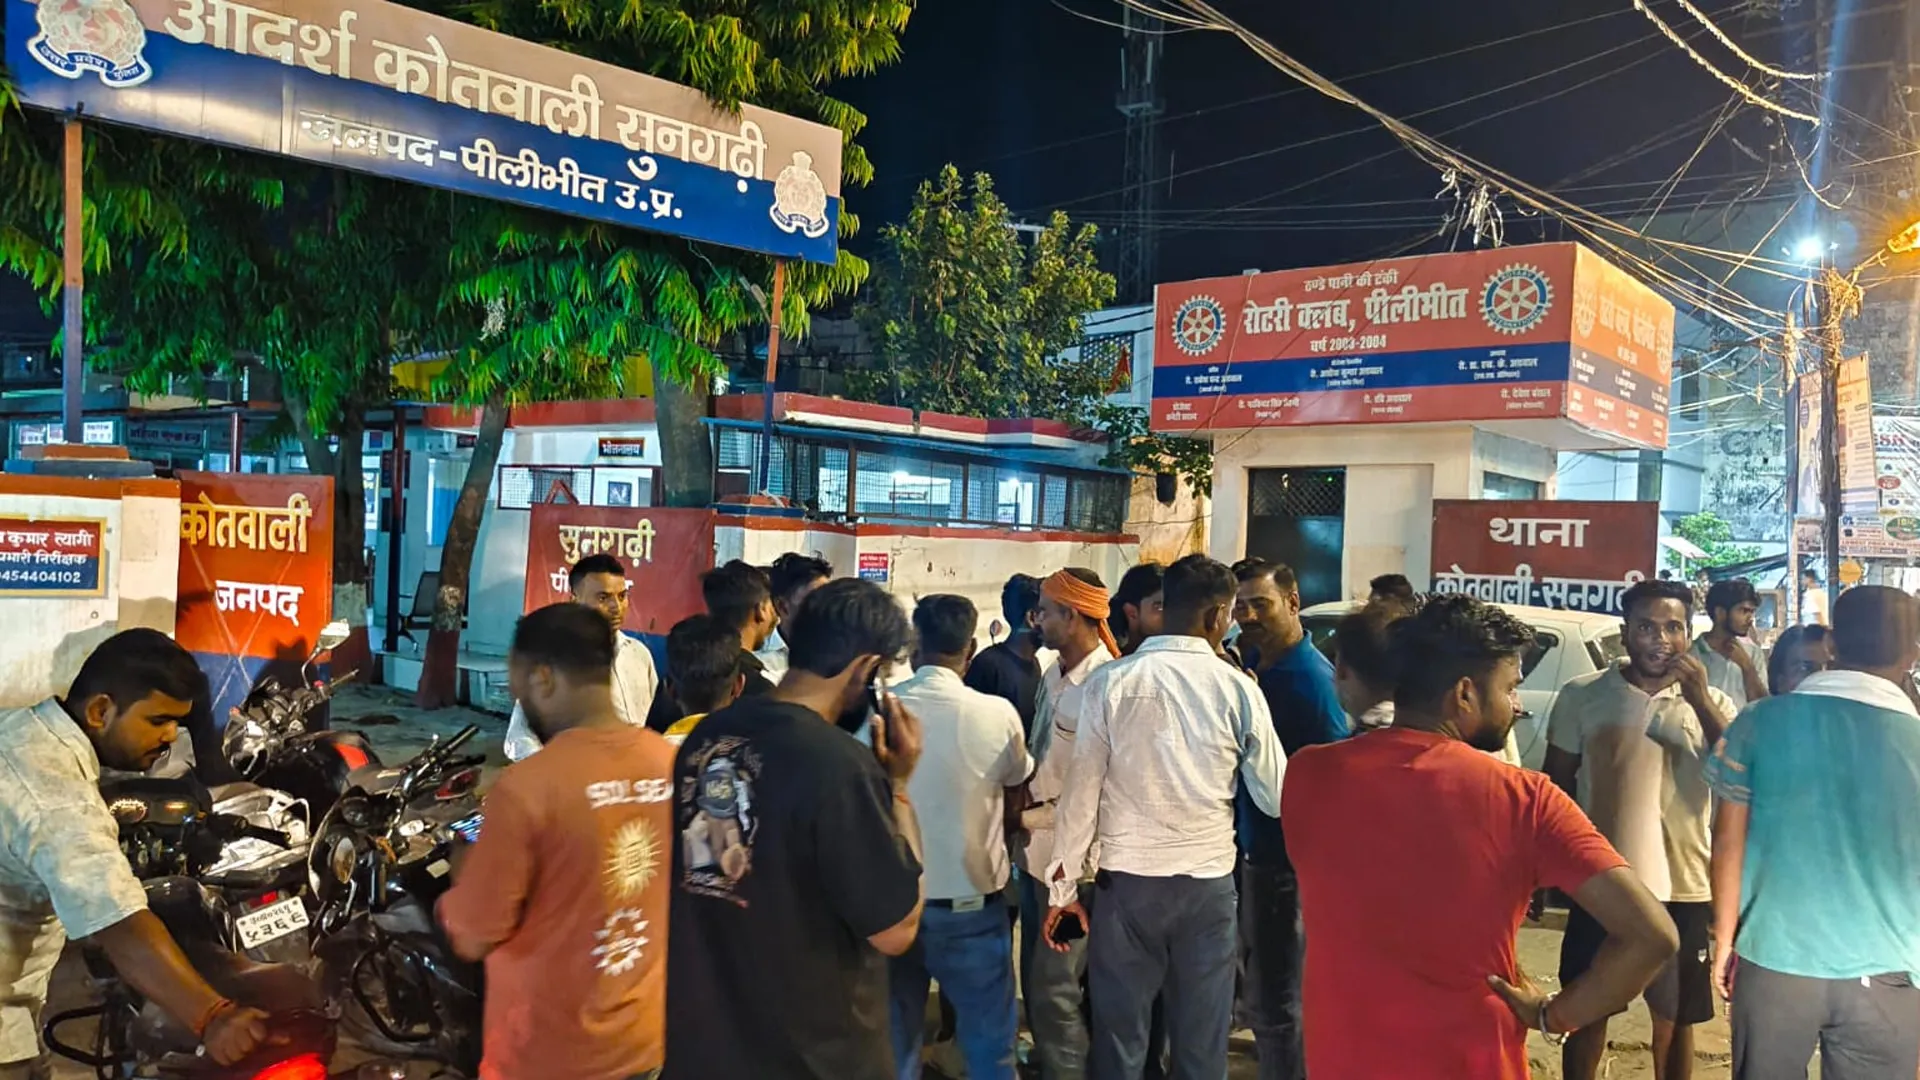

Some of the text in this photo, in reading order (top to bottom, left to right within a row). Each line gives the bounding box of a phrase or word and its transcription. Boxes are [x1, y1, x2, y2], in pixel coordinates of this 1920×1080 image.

[164, 0, 768, 194] आदर्श कोतवाली सुनगढ़ी
[615, 180, 683, 220] उ.प्र.
[1355, 271, 1373, 288] की
[1242, 282, 1470, 335] रोटरी क्लब, पीलीभीत
[7, 528, 95, 548] कुमार त्यागी
[180, 490, 313, 553] कोतवाली
[559, 518, 657, 568] सुनगढ़ी
[1489, 517, 1590, 548] थाना
[215, 580, 305, 627] जनपद
